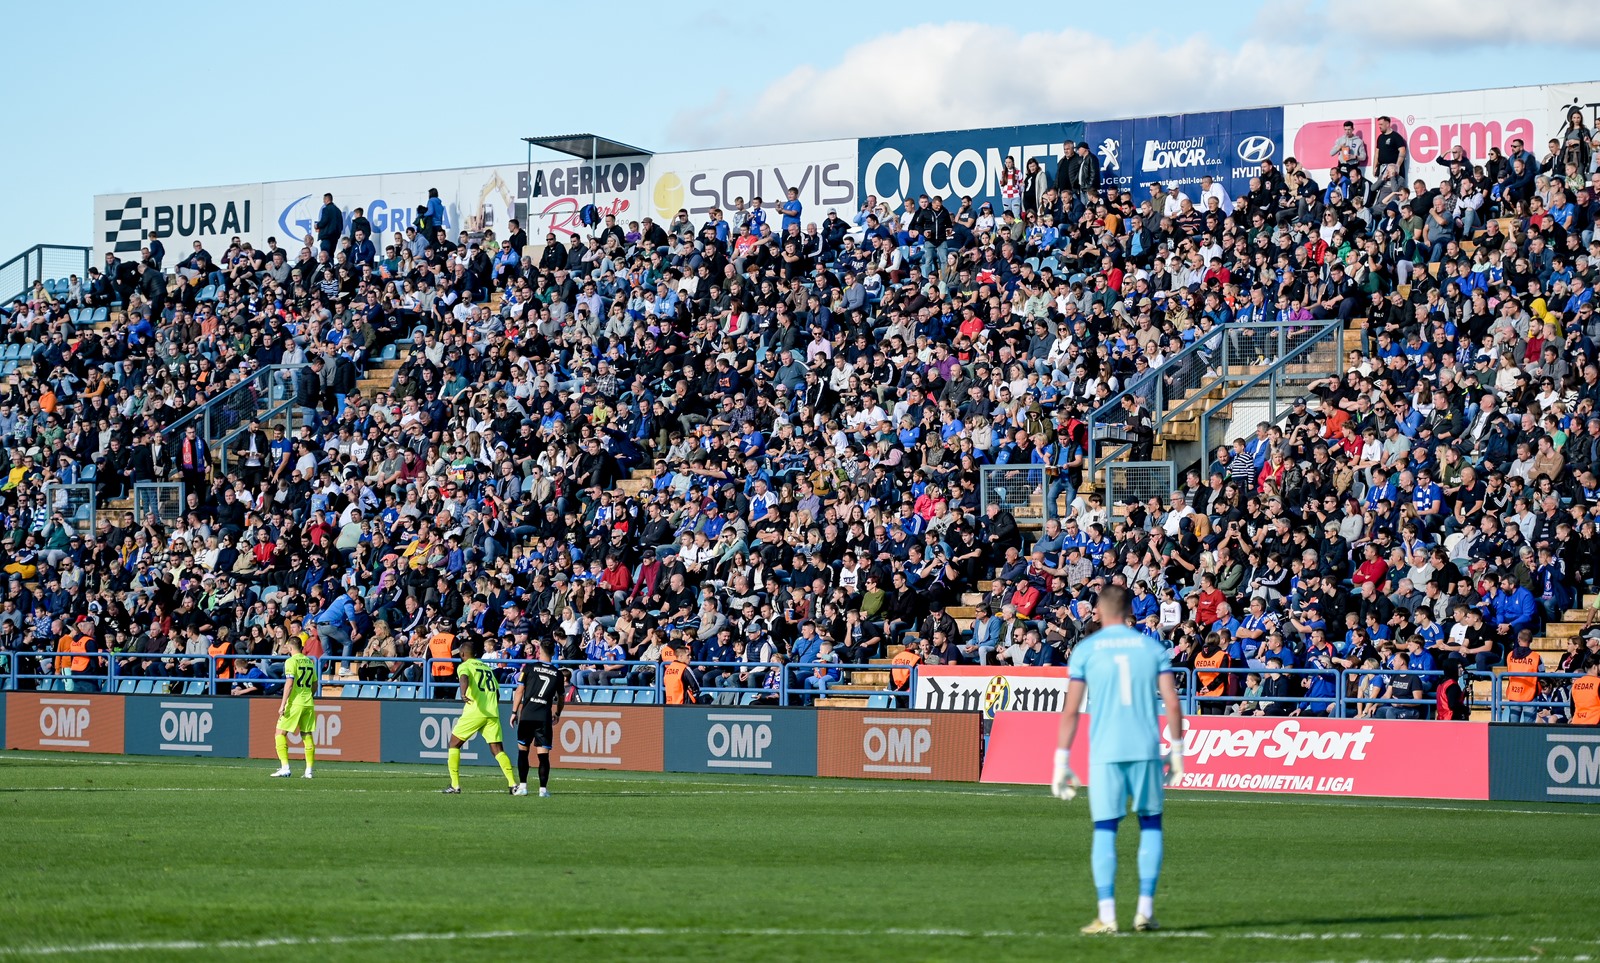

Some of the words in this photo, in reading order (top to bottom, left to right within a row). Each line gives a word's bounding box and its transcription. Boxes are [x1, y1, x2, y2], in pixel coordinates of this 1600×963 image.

[1141, 138, 1206, 172] LONČAR
[1153, 136, 1204, 150] Automobil
[517, 162, 645, 199] BAGERKOP
[922, 142, 1076, 201] COM
[1100, 176, 1133, 186] UGEOT
[1232, 165, 1280, 179] HYUNI
[690, 163, 854, 214] SOLVIS
[154, 200, 250, 238] BURAI
[540, 197, 622, 237] Roert
[297, 666, 314, 688] 22
[475, 668, 496, 692] 28
[1114, 655, 1132, 706] 1
[1196, 660, 1216, 668] REDAR
[538, 674, 550, 698] 7
[1574, 683, 1594, 691] REDAR
[39, 706, 90, 738] OMP
[160, 710, 213, 743] OMP
[560, 719, 622, 754] OMP
[707, 723, 772, 758] OMP
[863, 727, 931, 763] OMP
[1159, 718, 1375, 766] SuperSport
[1216, 773, 1313, 790] NOGOMETNA
[1316, 776, 1355, 792] LIGA
